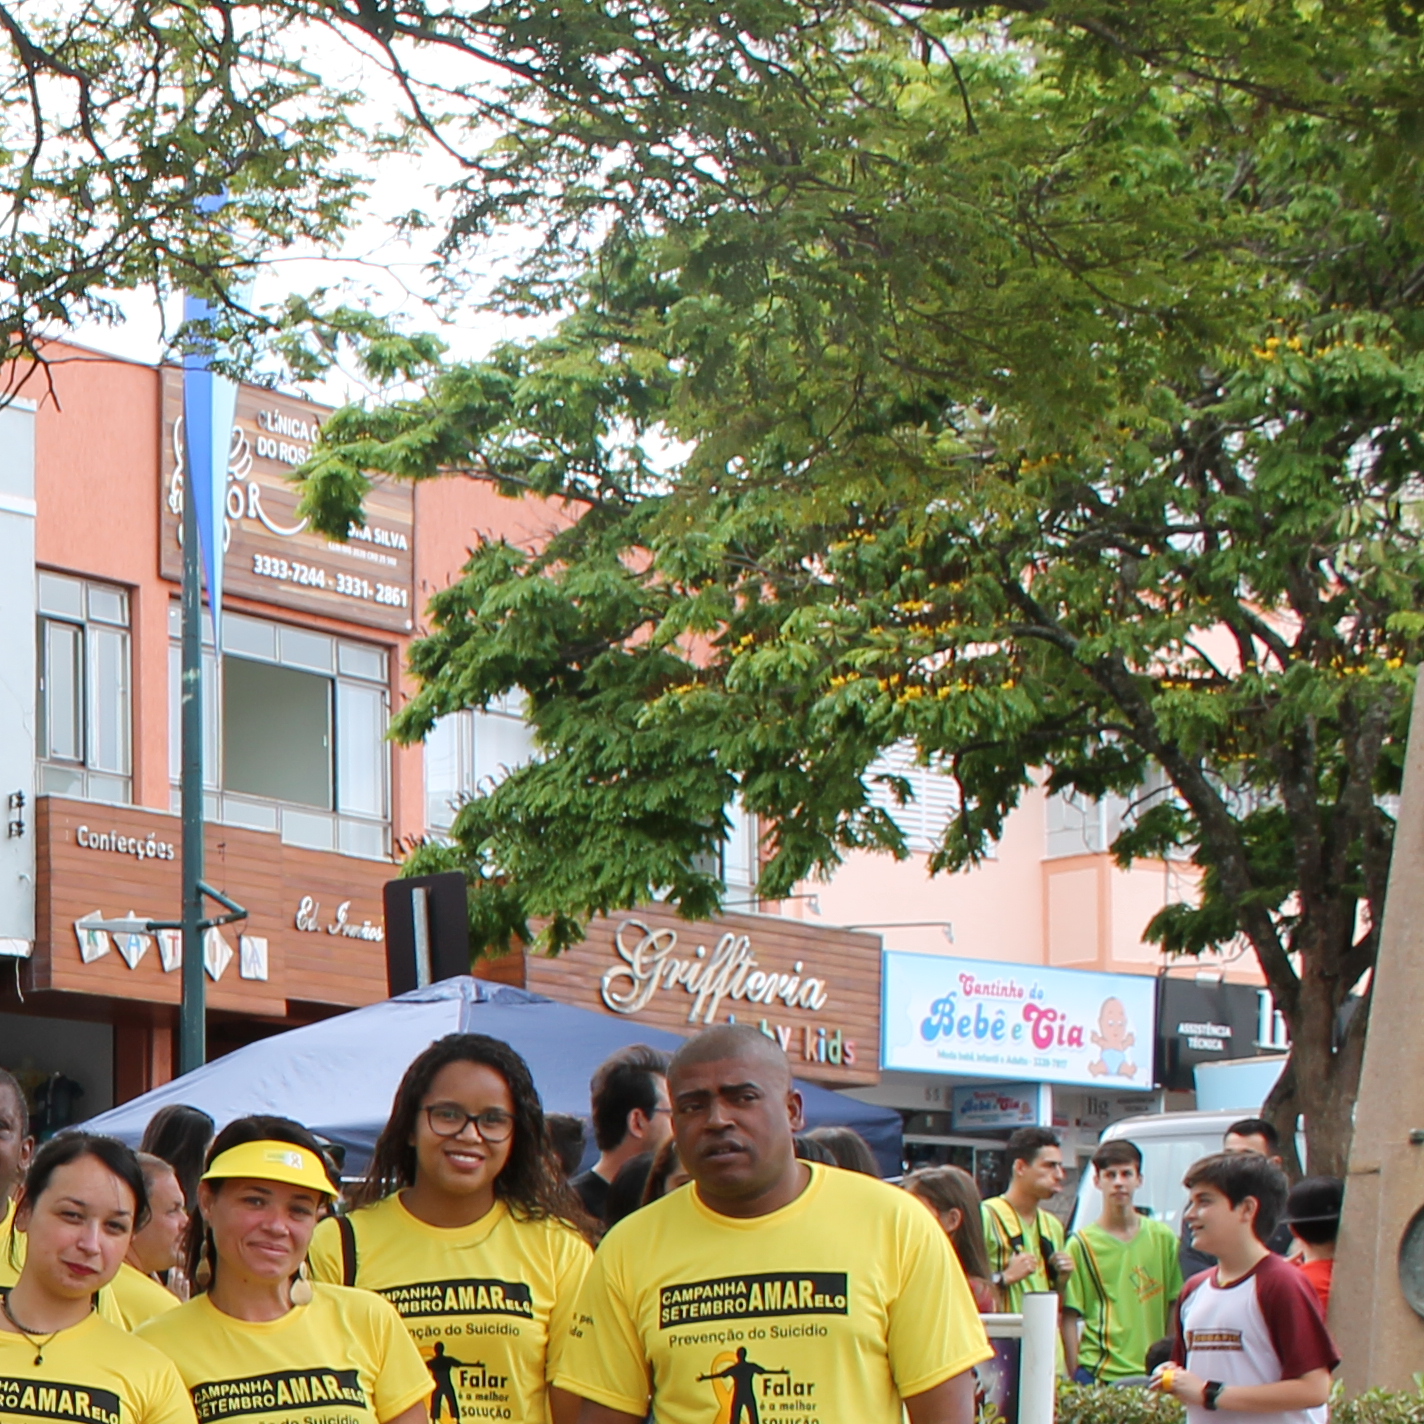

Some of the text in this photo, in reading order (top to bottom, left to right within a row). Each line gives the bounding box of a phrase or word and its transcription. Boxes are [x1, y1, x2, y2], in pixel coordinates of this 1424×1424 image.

[258, 409, 307, 438] CLÍNICA
[257, 436, 277, 458] DO
[374, 525, 408, 551] SILVA
[253, 554, 326, 588] 3333-7244
[375, 583, 408, 608] 2861
[76, 825, 175, 861] Confecções
[958, 973, 1044, 1000] Cantinho do
[921, 991, 1084, 1050] Bebê e Cia
[1178, 1021, 1232, 1038] ASSISTÊNCIA
[804, 1026, 857, 1066] kids
[1187, 1036, 1224, 1051] TÉCNICA
[661, 1280, 847, 1323] SETEMBRO AMARELO
[662, 1281, 747, 1305] CAMPANHA
[445, 1322, 520, 1337] do Suicídio
[669, 1323, 828, 1348] Prevenção do Suicídio
[460, 1370, 508, 1389] Falar
[762, 1377, 815, 1396] Falar
[475, 1391, 509, 1402] melhor
[779, 1401, 816, 1411] melhor
[460, 1402, 511, 1420] SOLUÇÃO
